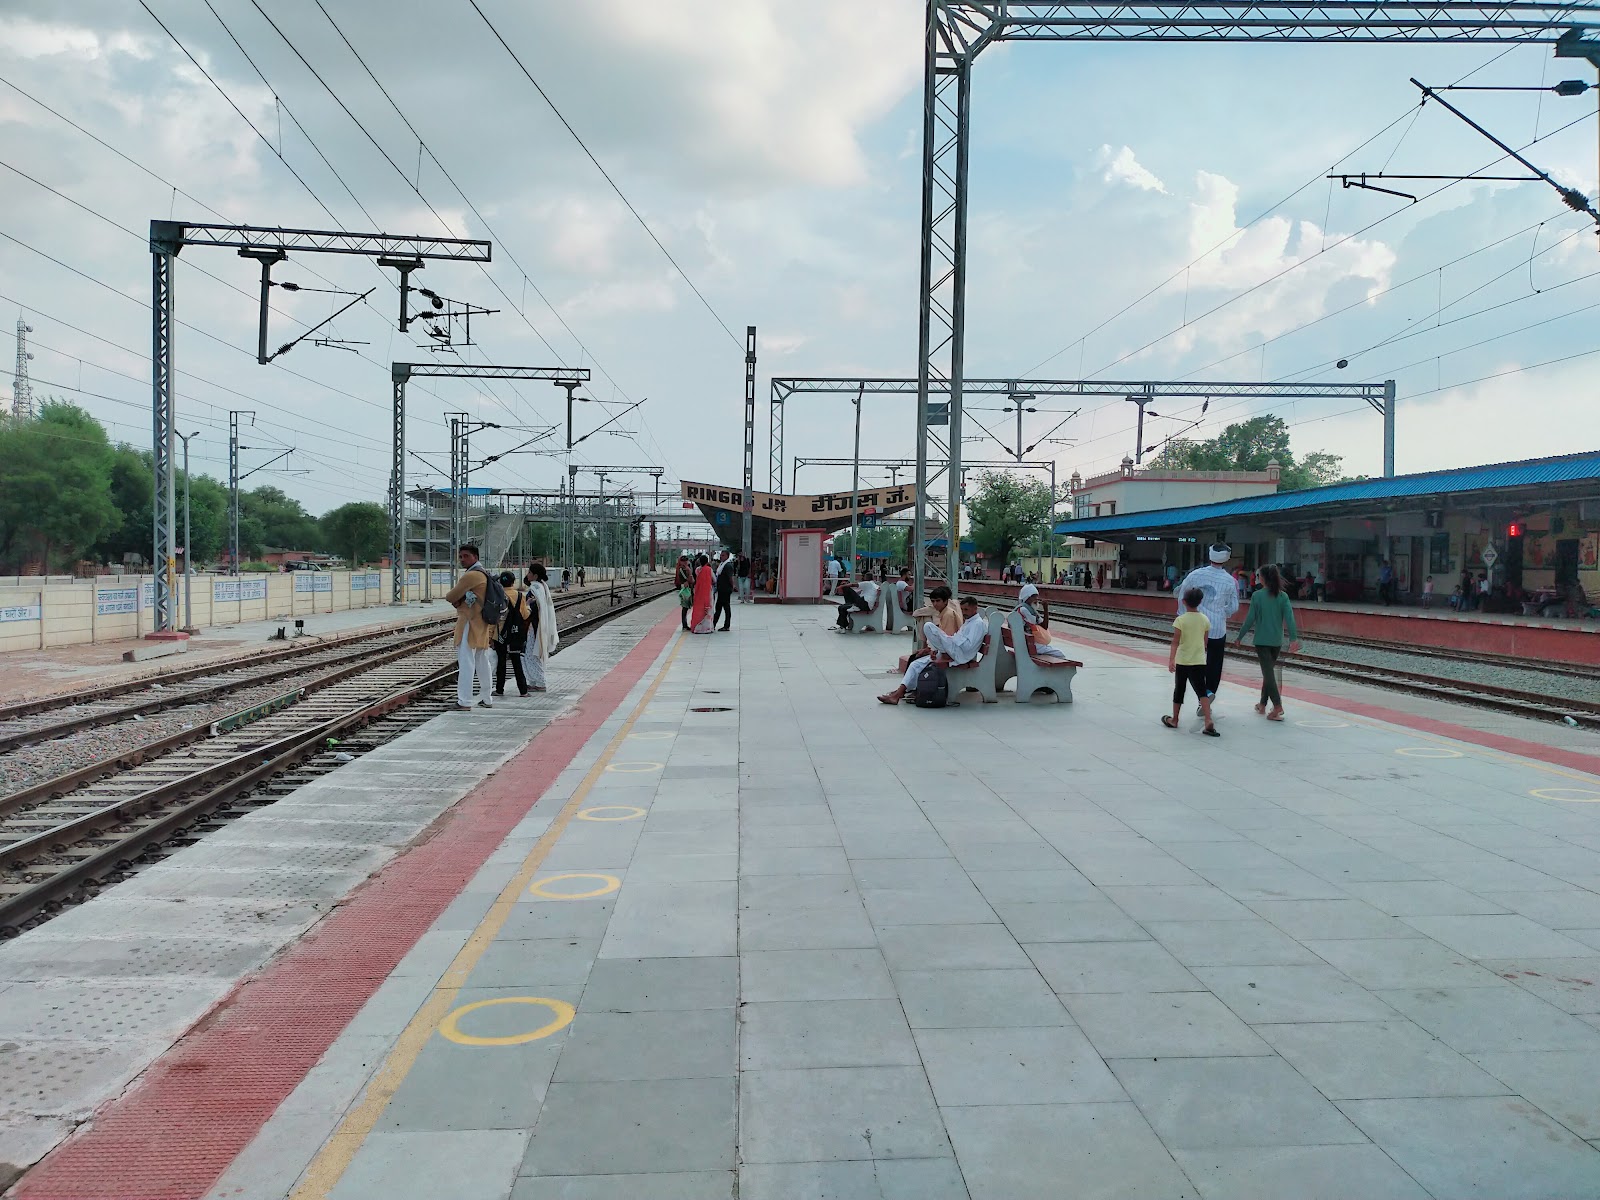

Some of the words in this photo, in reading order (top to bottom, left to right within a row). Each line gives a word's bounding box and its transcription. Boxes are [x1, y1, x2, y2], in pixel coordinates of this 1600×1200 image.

[687, 486, 754, 506] RINGA
[719, 511, 727, 522] 3
[865, 516, 873, 525] 2
[1431, 512, 1438, 526] 1
